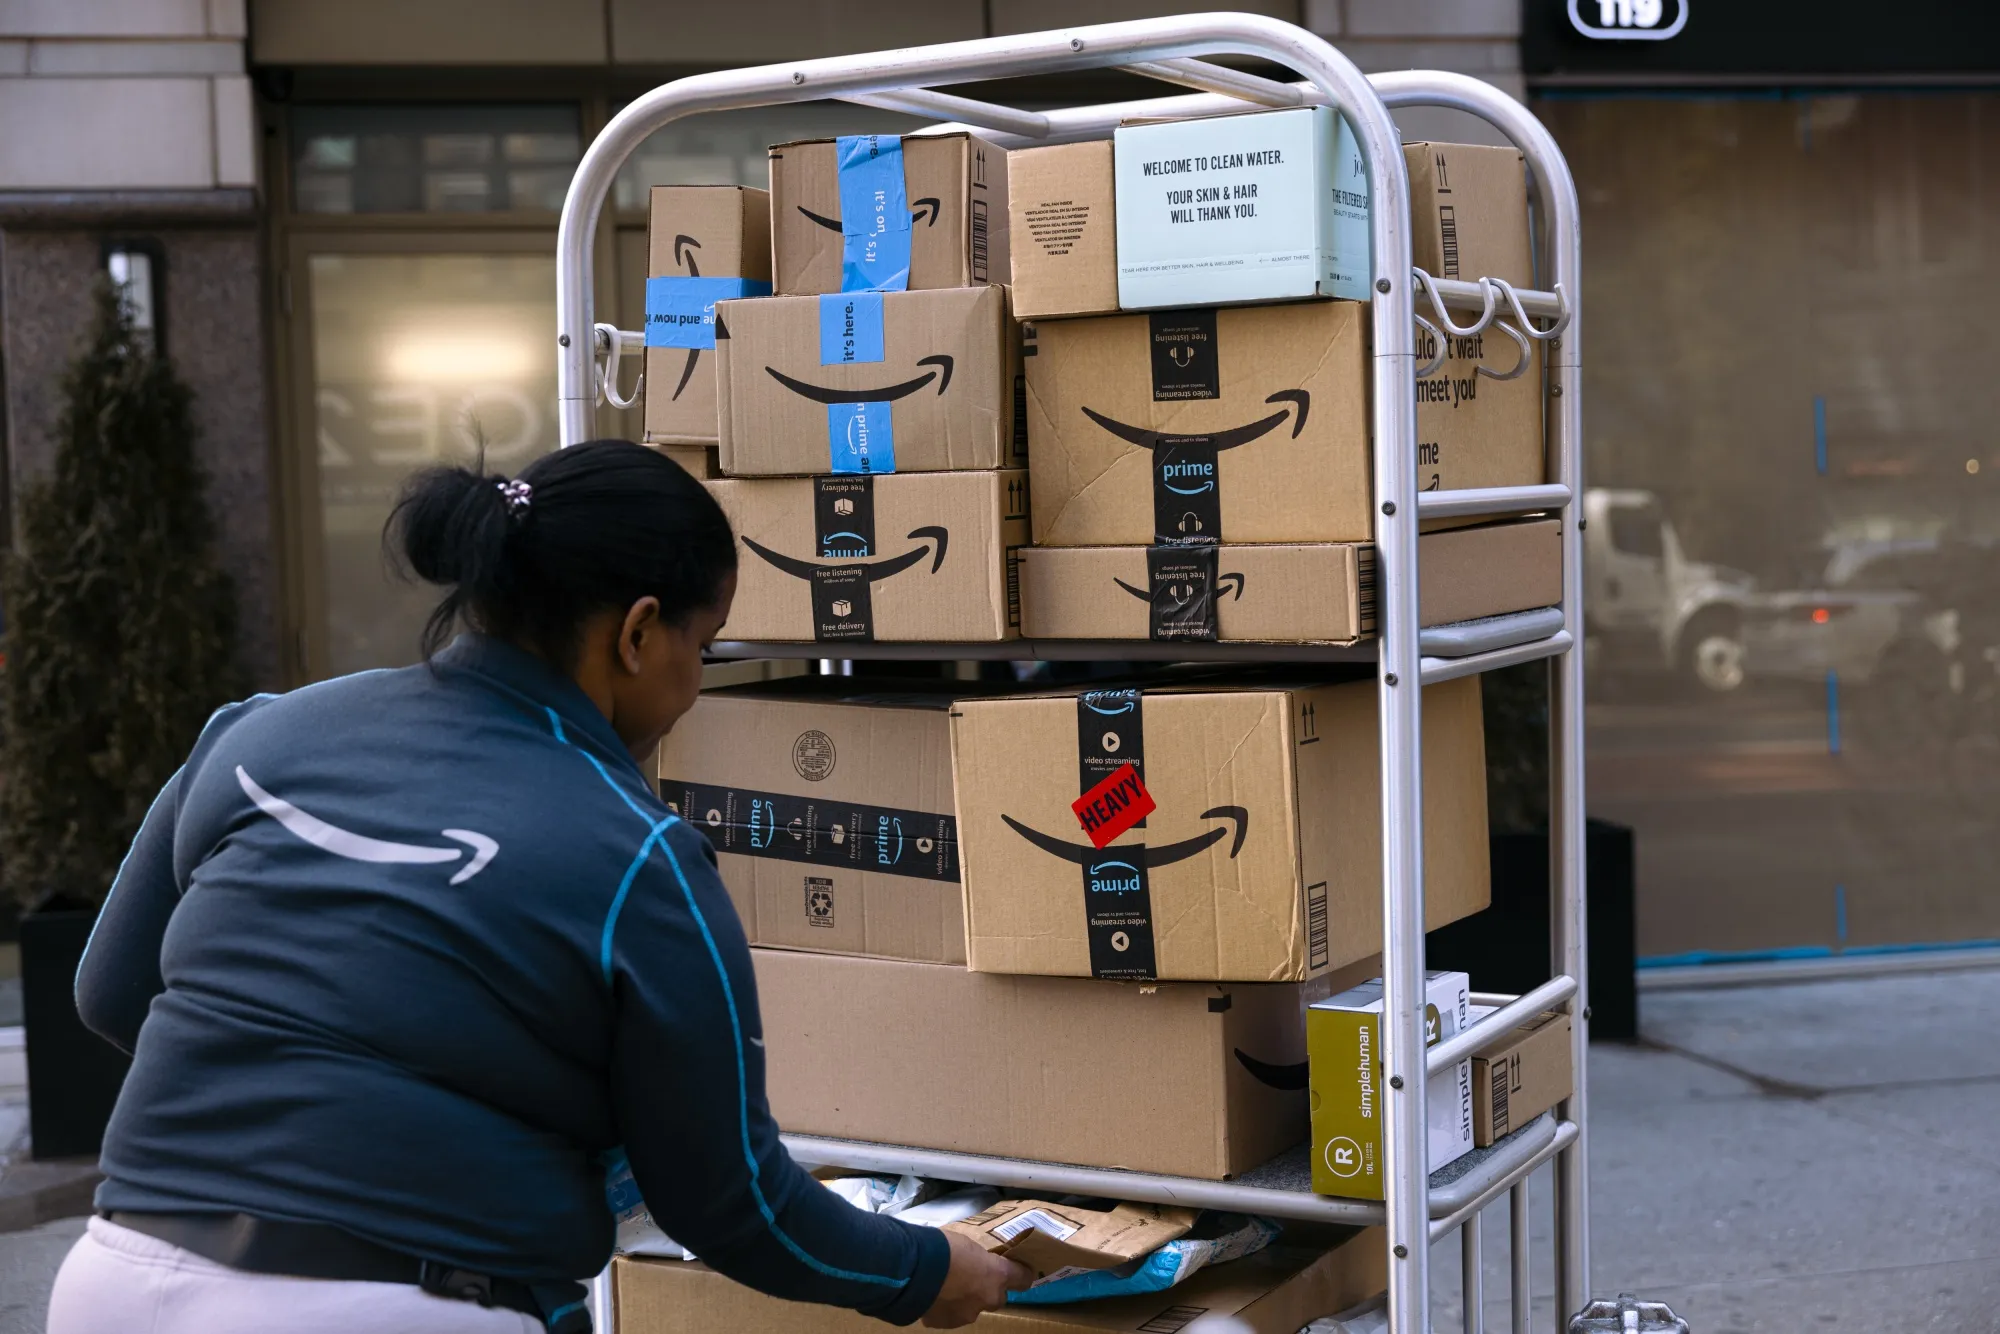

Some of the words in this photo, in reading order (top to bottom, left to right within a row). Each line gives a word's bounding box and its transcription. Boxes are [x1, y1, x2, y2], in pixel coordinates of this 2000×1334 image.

[1143, 158, 1192, 176] WELCOME
[1195, 157, 1207, 172] TO
[1210, 153, 1243, 170] CLEAN
[1246, 150, 1284, 166] WATER.
[874, 190, 885, 212] It's
[1166, 189, 1193, 205] YOUR
[1196, 186, 1220, 203] SKIN
[1223, 186, 1230, 200] &
[1234, 183, 1258, 199] HAIR
[1332, 188, 1342, 204] THE
[1342, 190, 1363, 208] FILTERED
[1170, 208, 1194, 224] WILL
[1197, 205, 1231, 222] THANK
[1234, 203, 1258, 219] YOU.
[1333, 208, 1347, 217] BEAUTY
[876, 215, 886, 233] on
[865, 240, 877, 262] It's
[1214, 259, 1244, 267] WELLBEING
[653, 314, 677, 324] now
[679, 315, 701, 327] and
[843, 301, 854, 338] here.
[1155, 334, 1189, 343] listening
[1191, 333, 1207, 341] free
[1415, 329, 1453, 361] uld't
[1456, 332, 1483, 360] wait
[843, 340, 855, 361] it's
[1155, 390, 1192, 400] streaming
[1192, 390, 1213, 398] video
[1417, 374, 1450, 403] meet
[1453, 377, 1476, 409] you
[856, 415, 868, 455] prime
[1163, 459, 1213, 482] prime
[821, 484, 849, 493] delivery
[850, 485, 864, 493] free
[832, 568, 862, 577] listening
[1155, 572, 1188, 581] listening
[1189, 572, 1206, 580] free
[822, 623, 836, 631] free
[837, 622, 865, 630] delivery
[1157, 628, 1190, 637] streaming
[1190, 628, 1210, 636] video
[1084, 756, 1104, 765] video
[1104, 756, 1140, 767] streaming
[725, 791, 734, 827] sreaming
[1079, 773, 1142, 833] HEAVY
[748, 799, 764, 848] prime
[874, 815, 891, 865] prime
[937, 819, 946, 854] streming
[1091, 874, 1140, 896] prime
[1091, 918, 1126, 927] streaming
[1127, 919, 1147, 927] video
[1358, 1025, 1372, 1118] simplehuman
[1335, 1147, 1353, 1165] R
[1366, 1161, 1374, 1176] 10L
